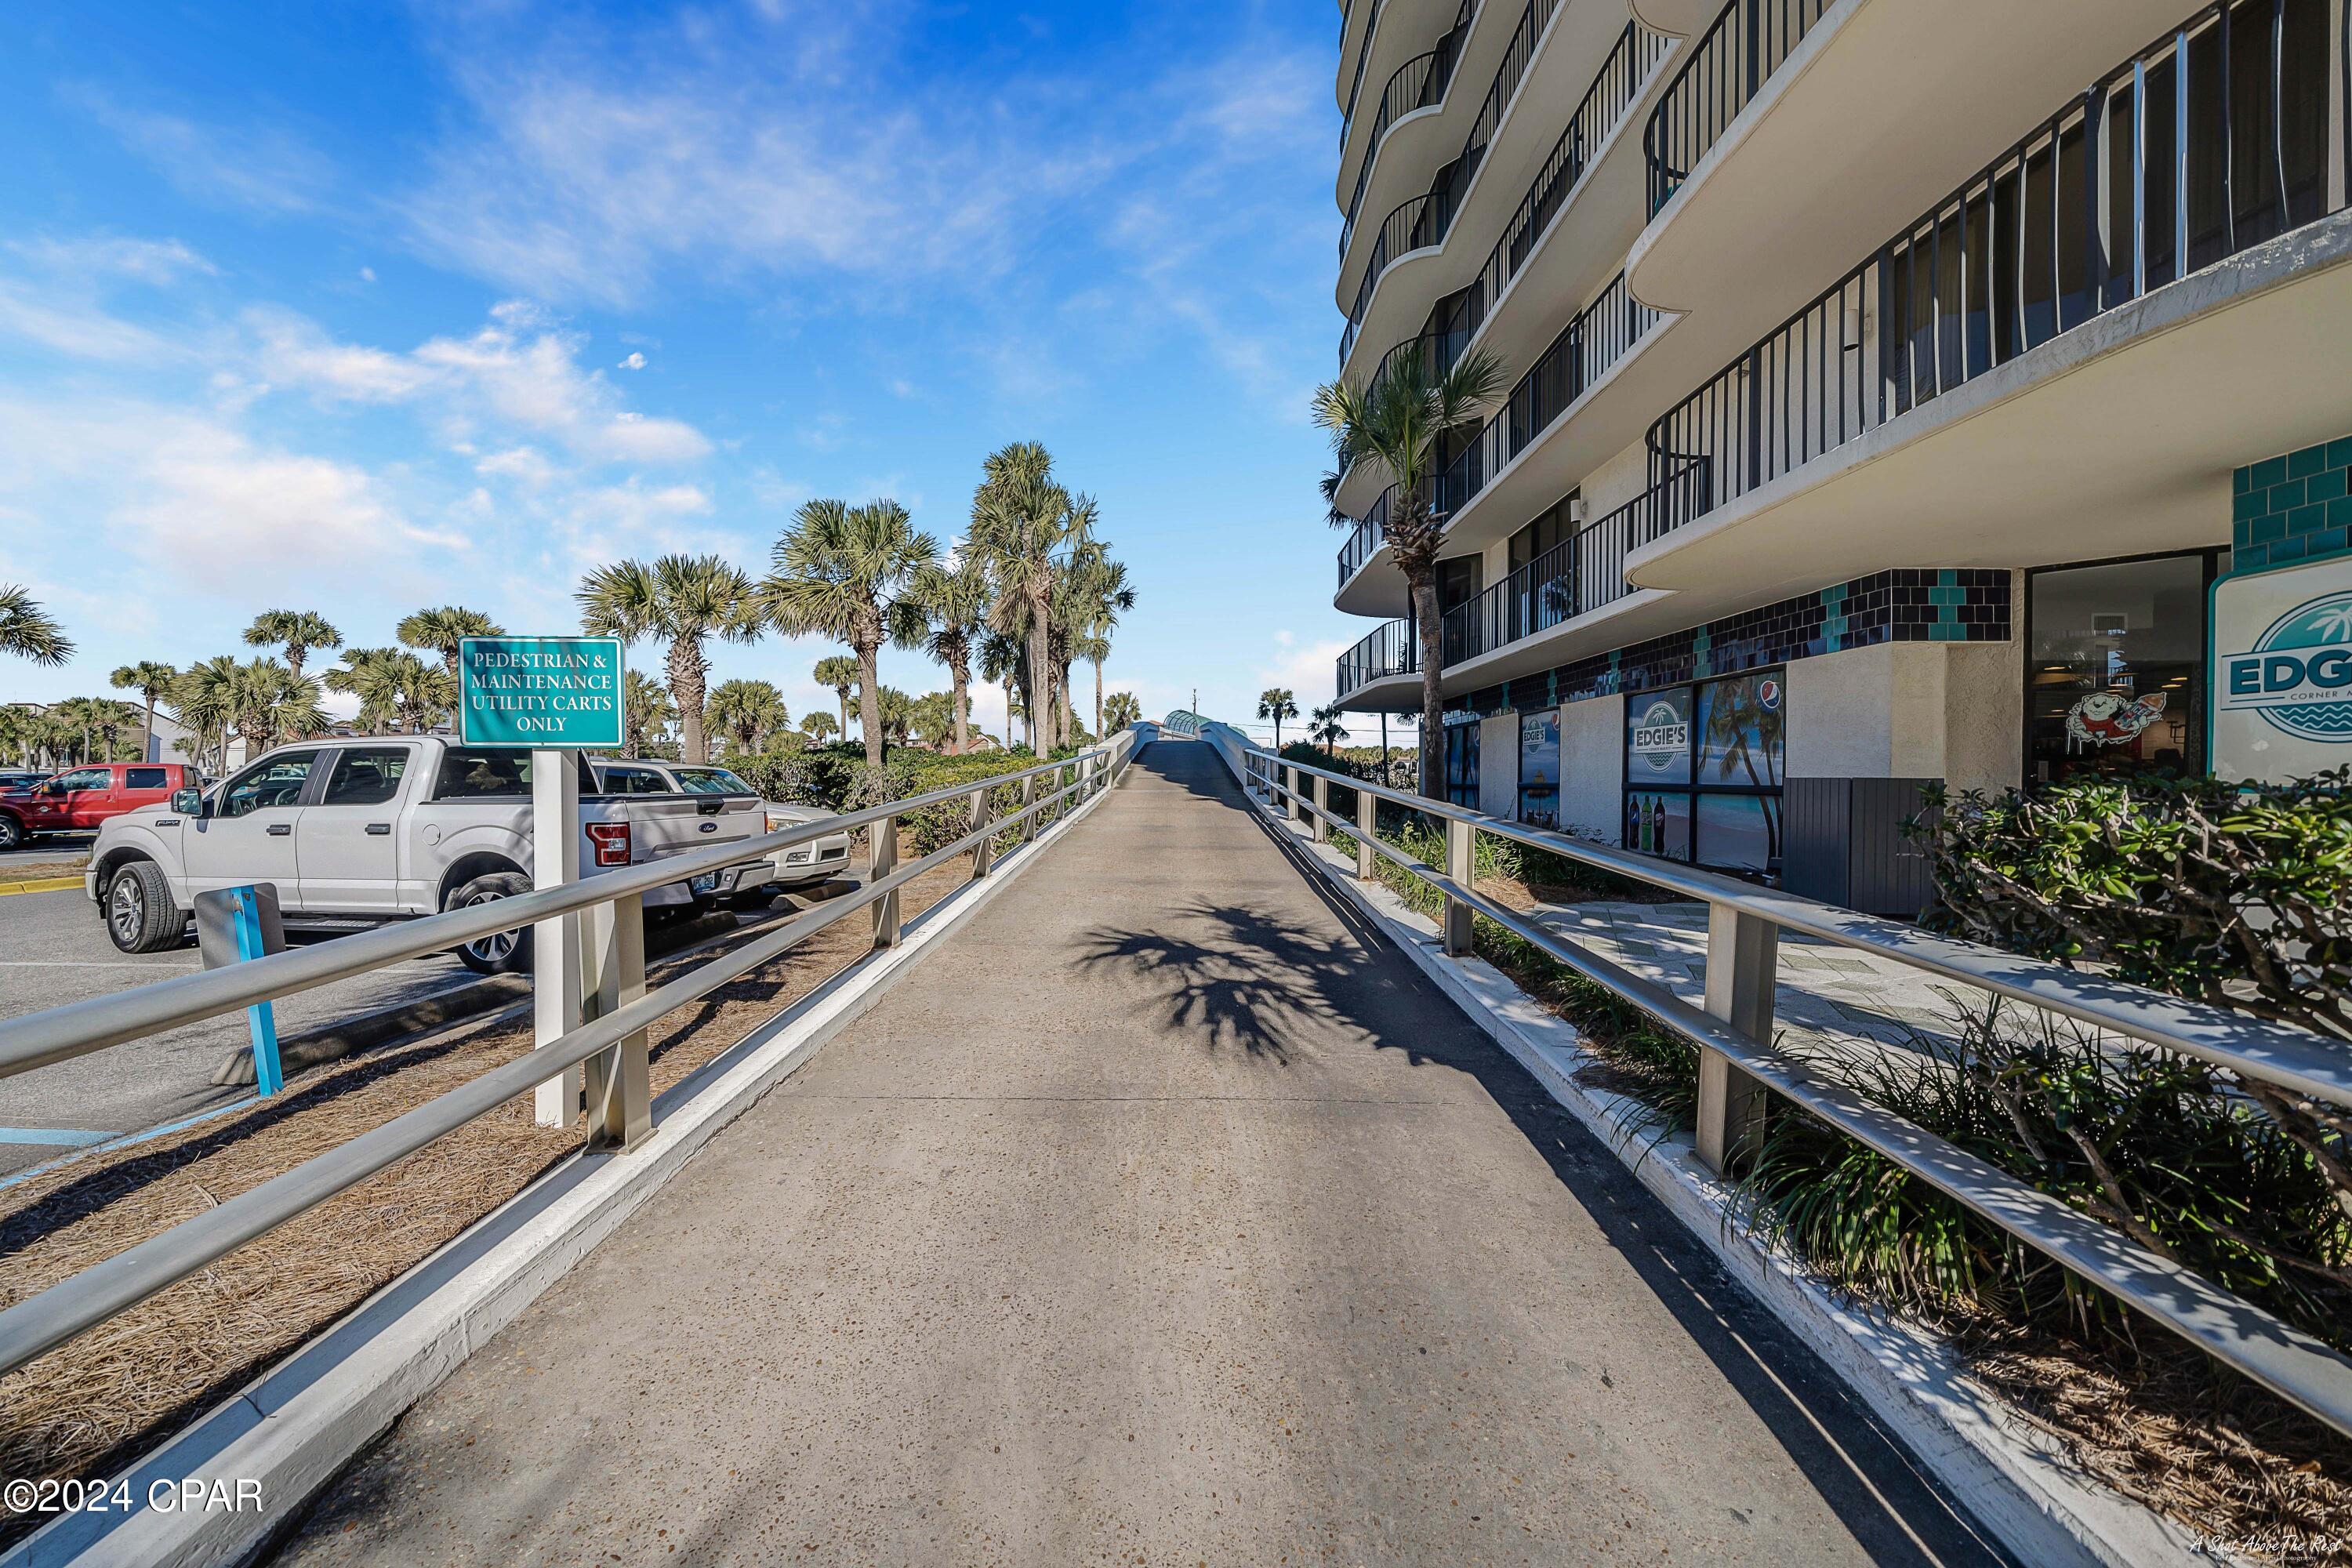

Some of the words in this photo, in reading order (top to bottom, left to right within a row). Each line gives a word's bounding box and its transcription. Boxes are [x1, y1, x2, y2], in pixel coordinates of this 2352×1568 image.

[474, 652, 589, 668] PEDESTRIAN
[593, 655, 607, 668] &
[471, 674, 612, 689] MAINTENANCE
[472, 695, 549, 710] UTILITY
[553, 696, 612, 710] CARTS
[2290, 691, 2339, 700] CORNER
[517, 717, 568, 731] ONLY
[1524, 730, 1544, 741] EDGIE'S
[1636, 726, 1686, 746] EDGIE'S
